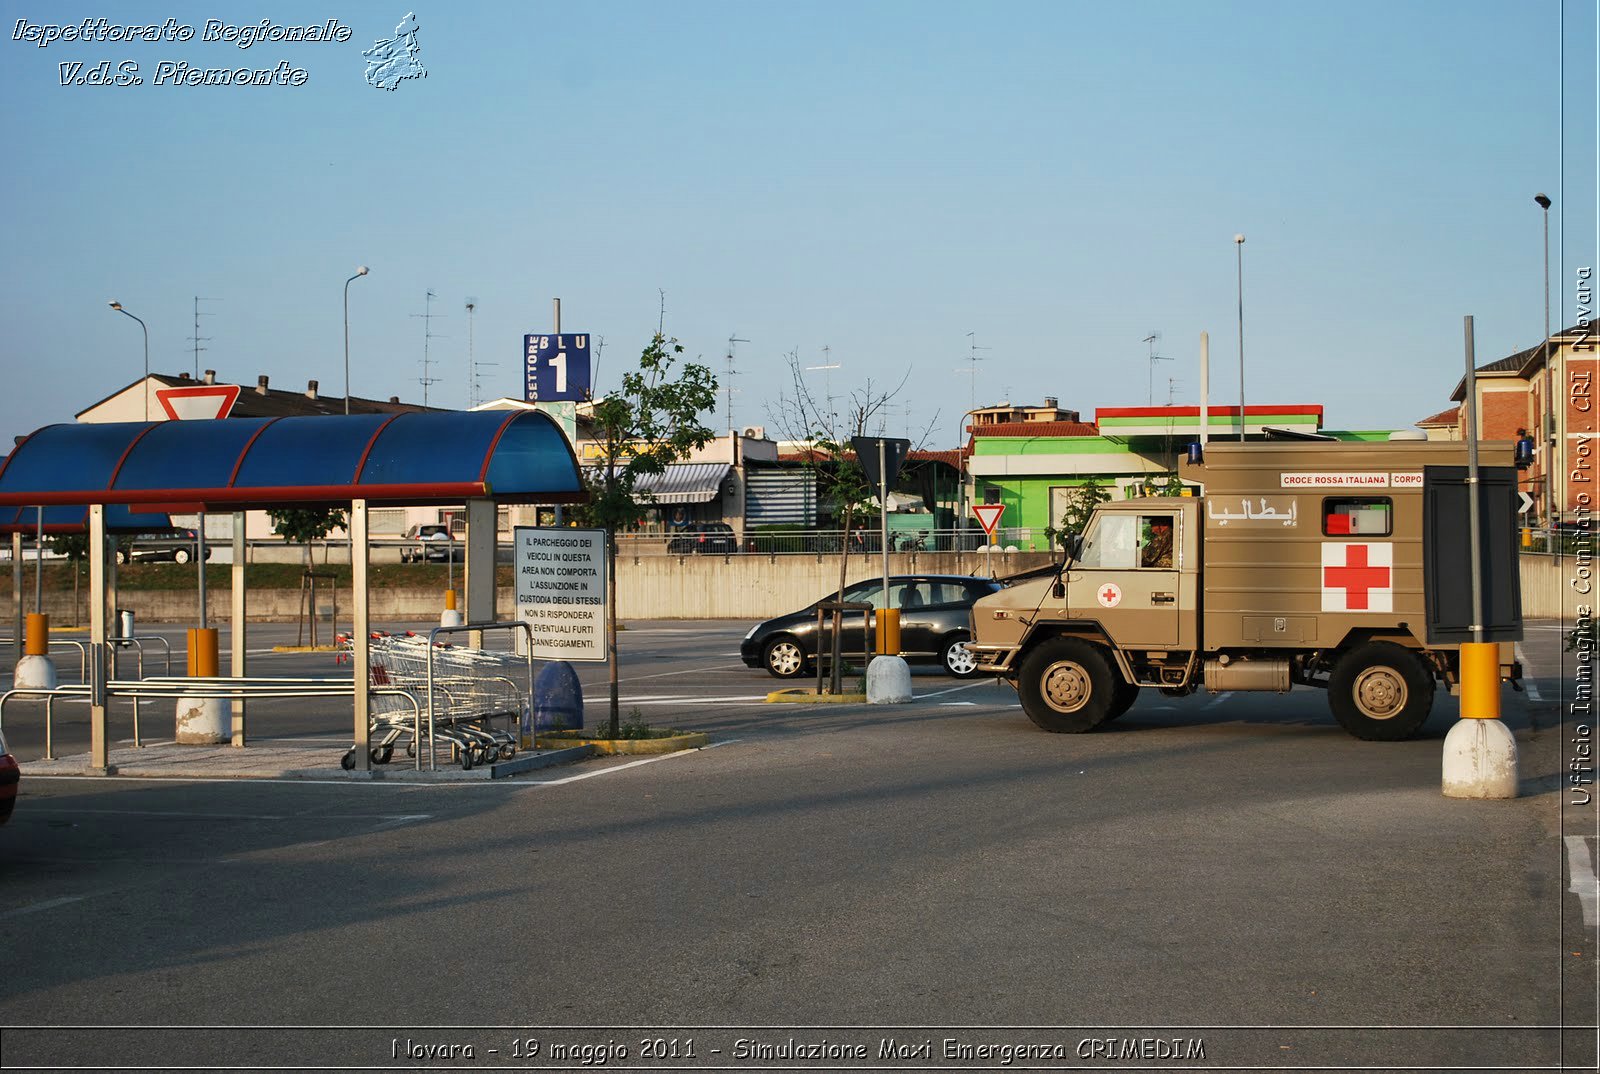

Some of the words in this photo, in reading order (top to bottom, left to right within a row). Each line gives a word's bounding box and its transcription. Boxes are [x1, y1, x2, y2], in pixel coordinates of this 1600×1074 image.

[527, 336, 539, 400] SETTORE
[548, 352, 567, 393] 1
[1284, 476, 1312, 484] CROCE
[1315, 476, 1344, 484] ROSSA
[1346, 476, 1385, 484] ITALIANA
[1394, 475, 1422, 483] CORPO
[1207, 498, 1297, 526] إيطاليا
[526, 537, 531, 546] IL
[533, 537, 578, 548] PARCHEGGIO
[580, 539, 592, 548] DEI
[527, 552, 552, 561] VEICOLI
[554, 553, 561, 561] IN
[562, 553, 591, 562] QUESTA
[522, 566, 540, 575] AREA
[541, 567, 555, 576] NON
[556, 567, 597, 577] COMPORTA
[530, 581, 579, 591] L'ASSUNZIONE
[581, 583, 588, 591] IN
[519, 594, 552, 604] CUSTODIA
[553, 596, 574, 605] DEGLI
[575, 596, 602, 606] STESSI.
[525, 609, 538, 618] NON
[540, 610, 546, 618] SI
[547, 610, 595, 620] RISPONDERA'
[534, 624, 571, 634] EVENTUALI
[573, 625, 594, 634] FURTI
